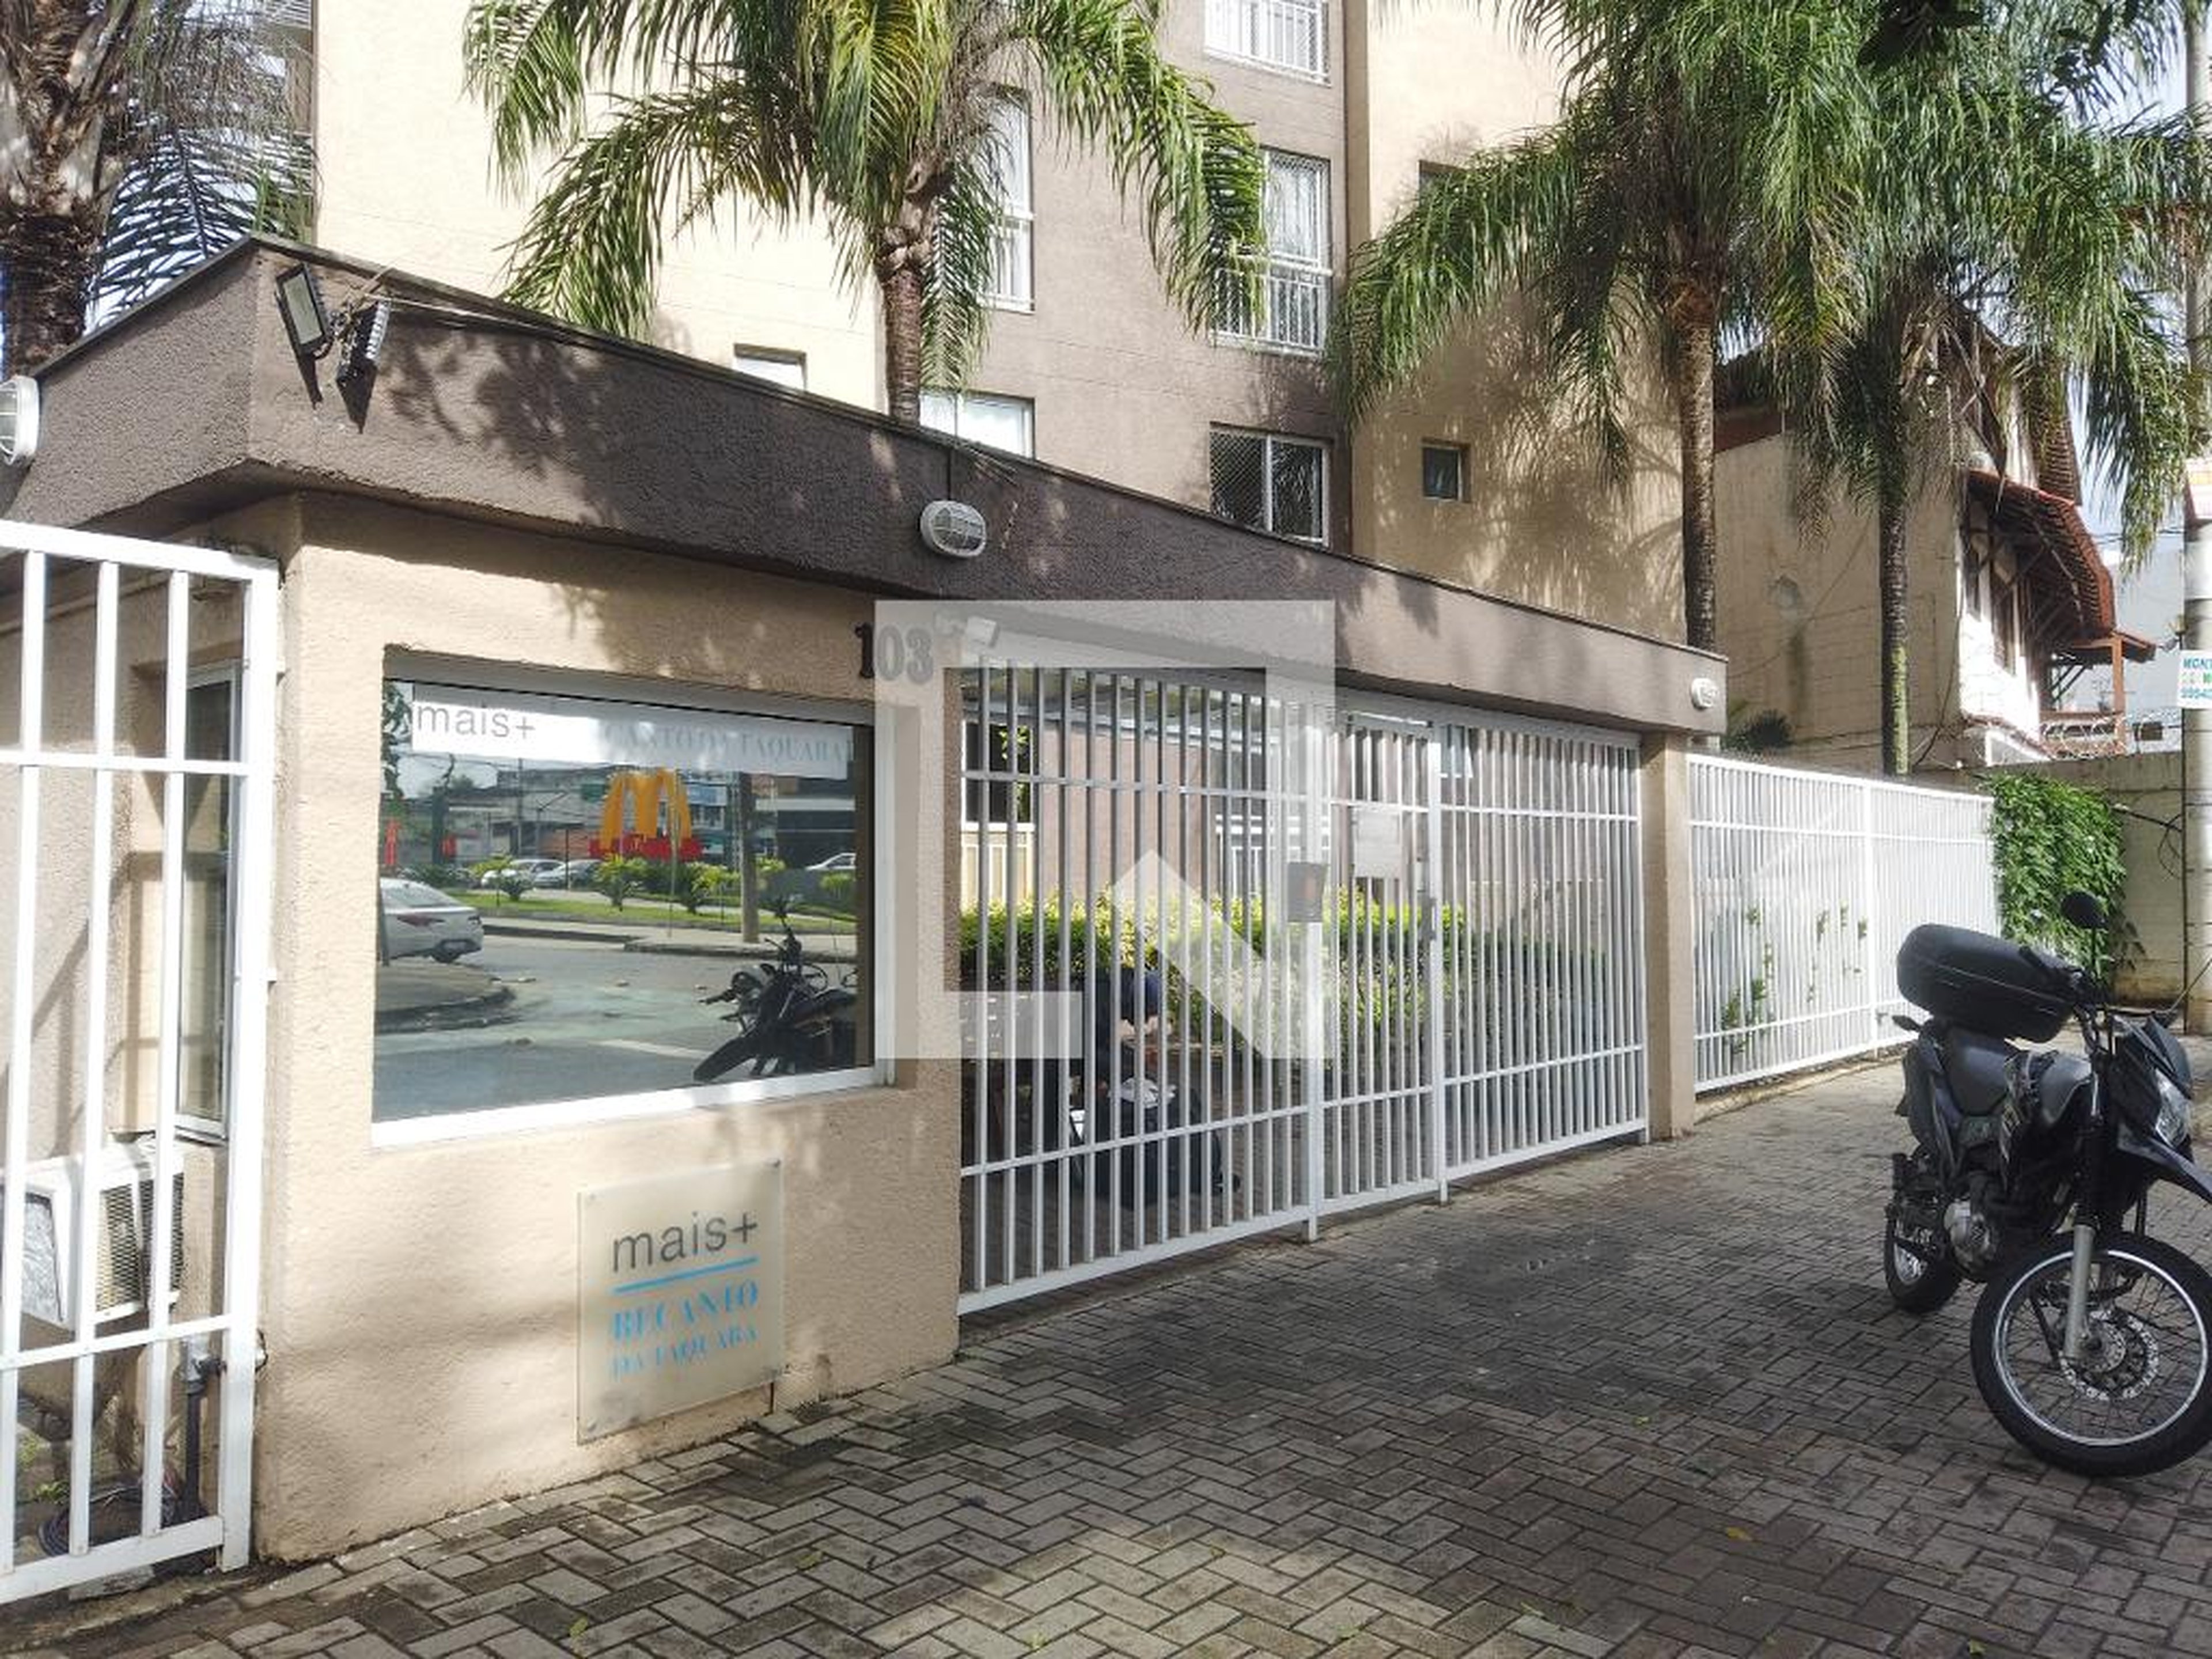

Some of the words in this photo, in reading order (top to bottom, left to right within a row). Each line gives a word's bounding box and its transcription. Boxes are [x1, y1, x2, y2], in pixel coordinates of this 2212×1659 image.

[854, 622, 934, 685] 103
[418, 703, 536, 739] mais+
[613, 1210, 757, 1272] mais+
[613, 1279, 757, 1343] RECANTO
